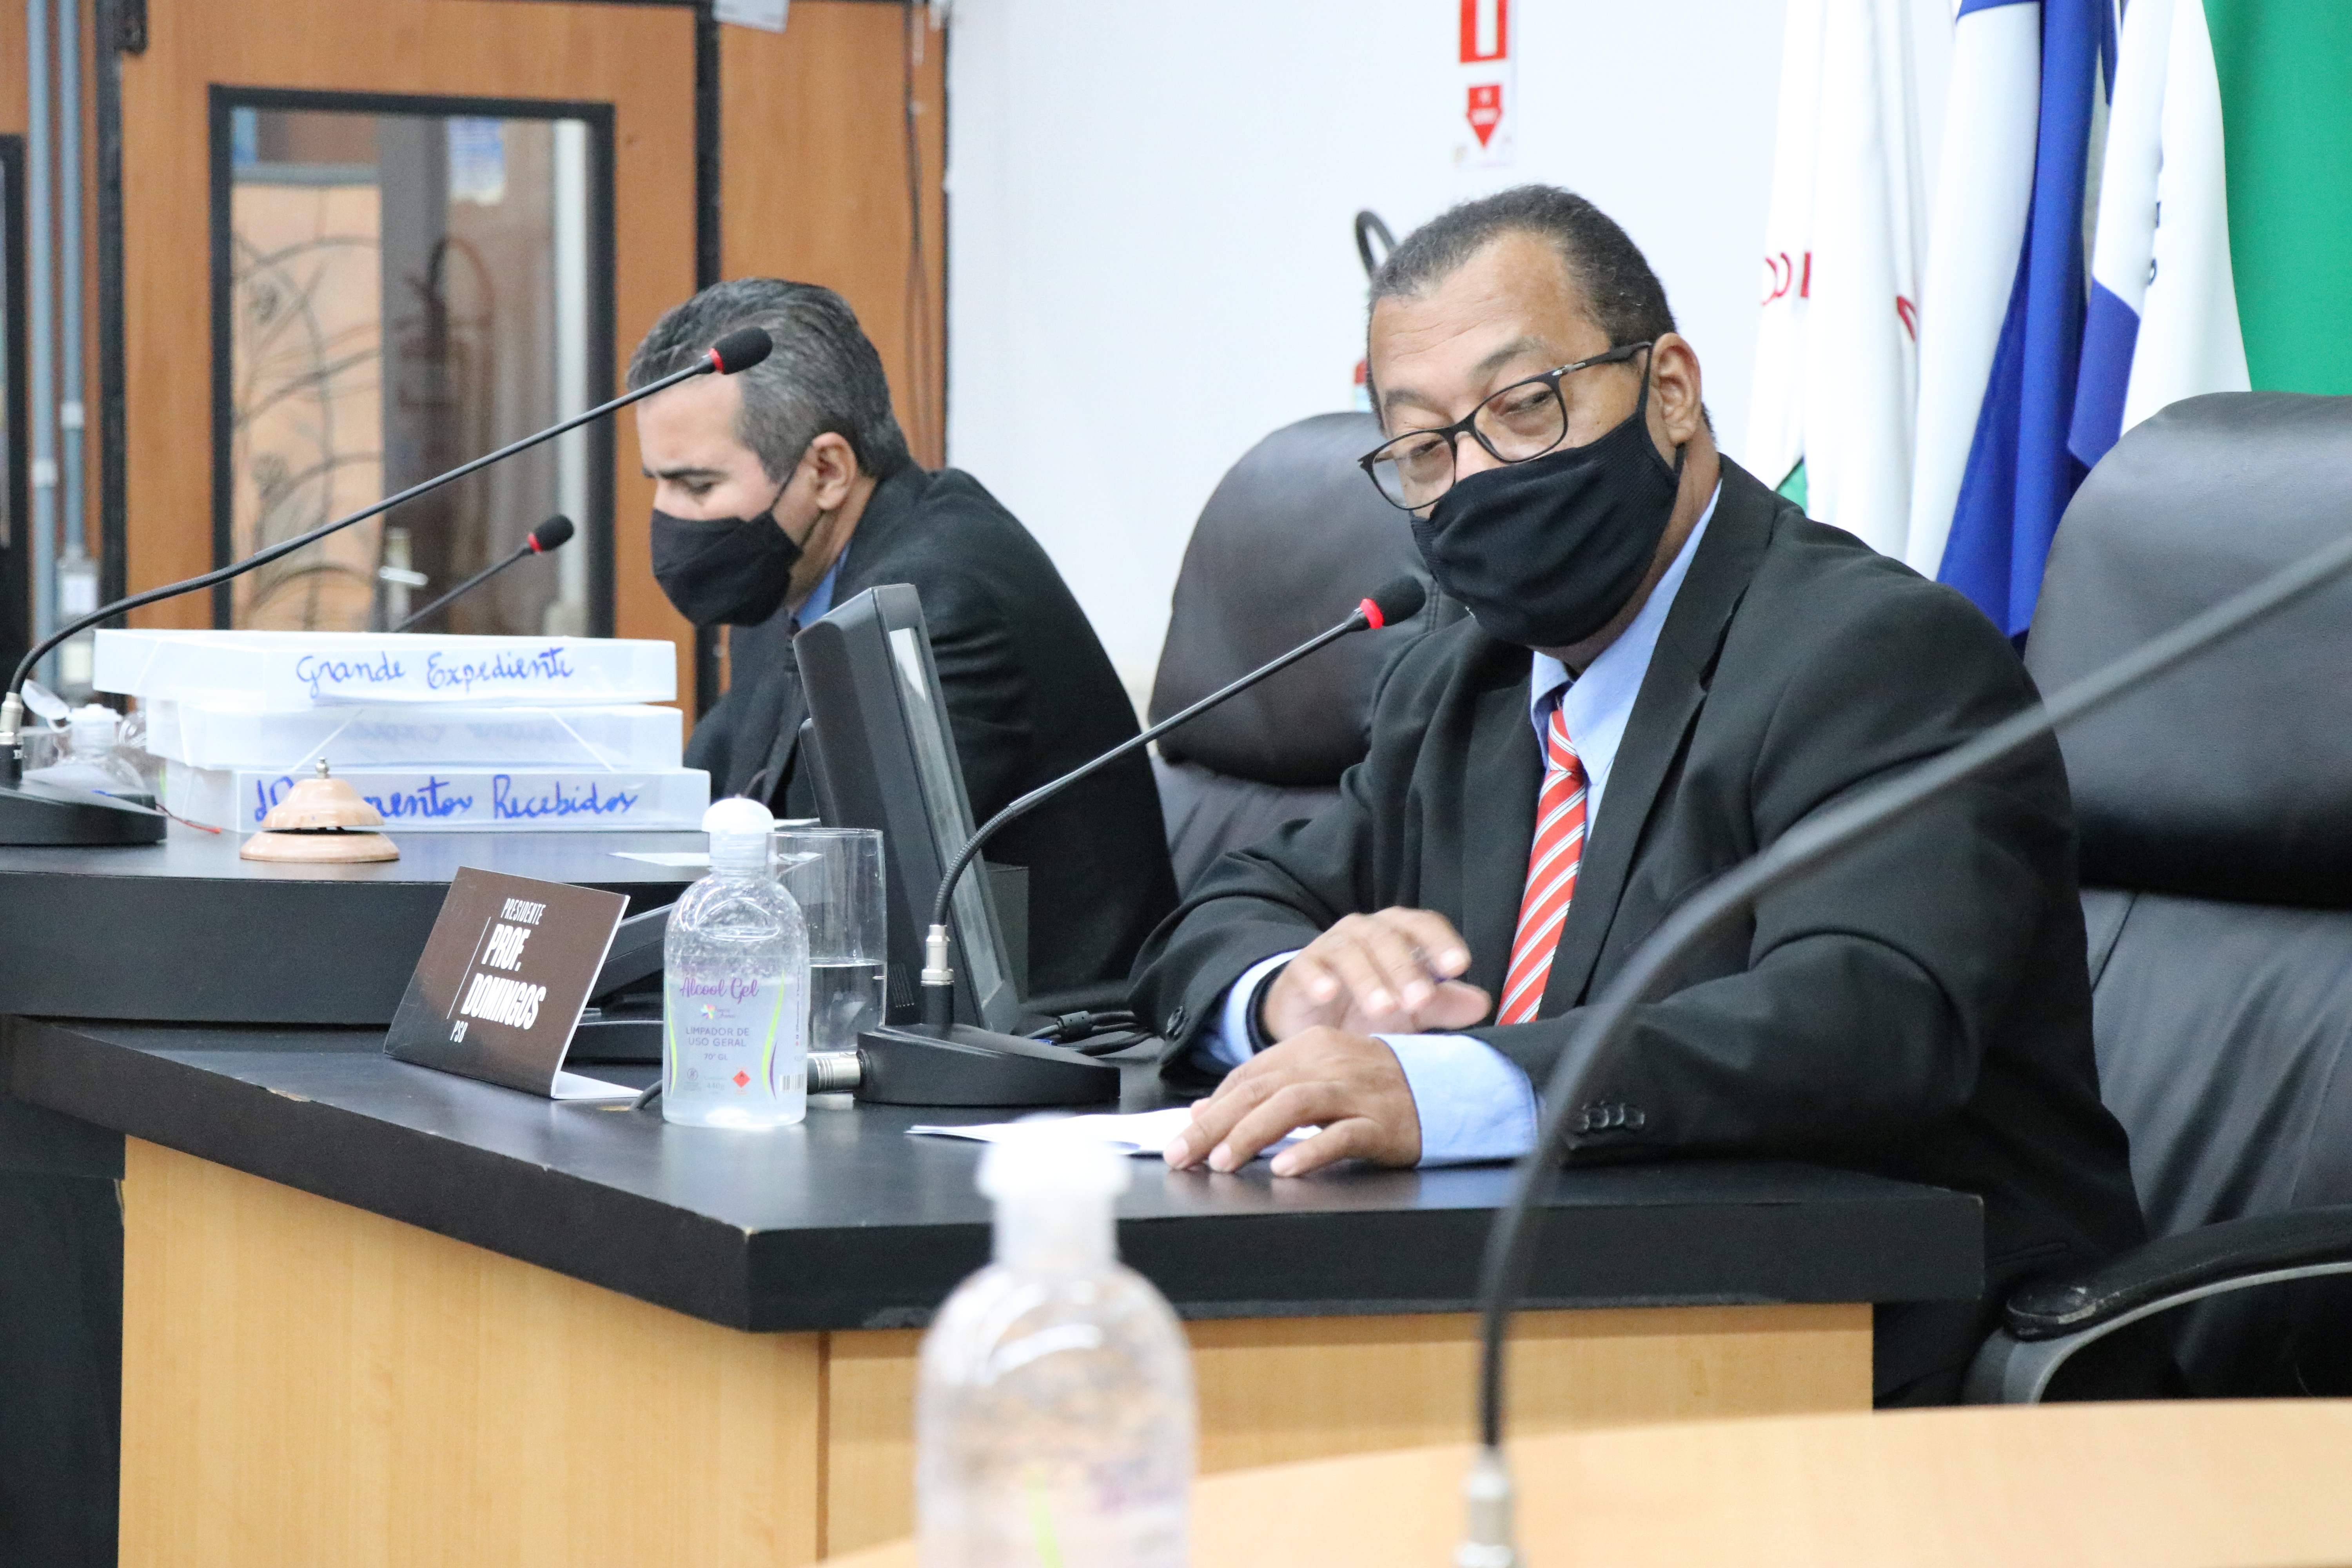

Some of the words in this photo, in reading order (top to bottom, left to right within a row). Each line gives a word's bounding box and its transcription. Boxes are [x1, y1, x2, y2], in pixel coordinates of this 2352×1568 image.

[296, 651, 405, 699] Grande
[427, 647, 574, 692] Expediente
[493, 774, 639, 819] Recebidos
[500, 898, 546, 925] PRESIDENTE
[481, 924, 531, 971] PROF.
[460, 973, 546, 1030] DOMINGOS
[680, 977, 727, 997] Alcool
[731, 978, 760, 1004] Gel
[450, 1020, 468, 1043] PSB
[686, 1027, 733, 1036] LIMPADOR
[689, 1037, 709, 1046] USO
[713, 1038, 746, 1047] GERAL
